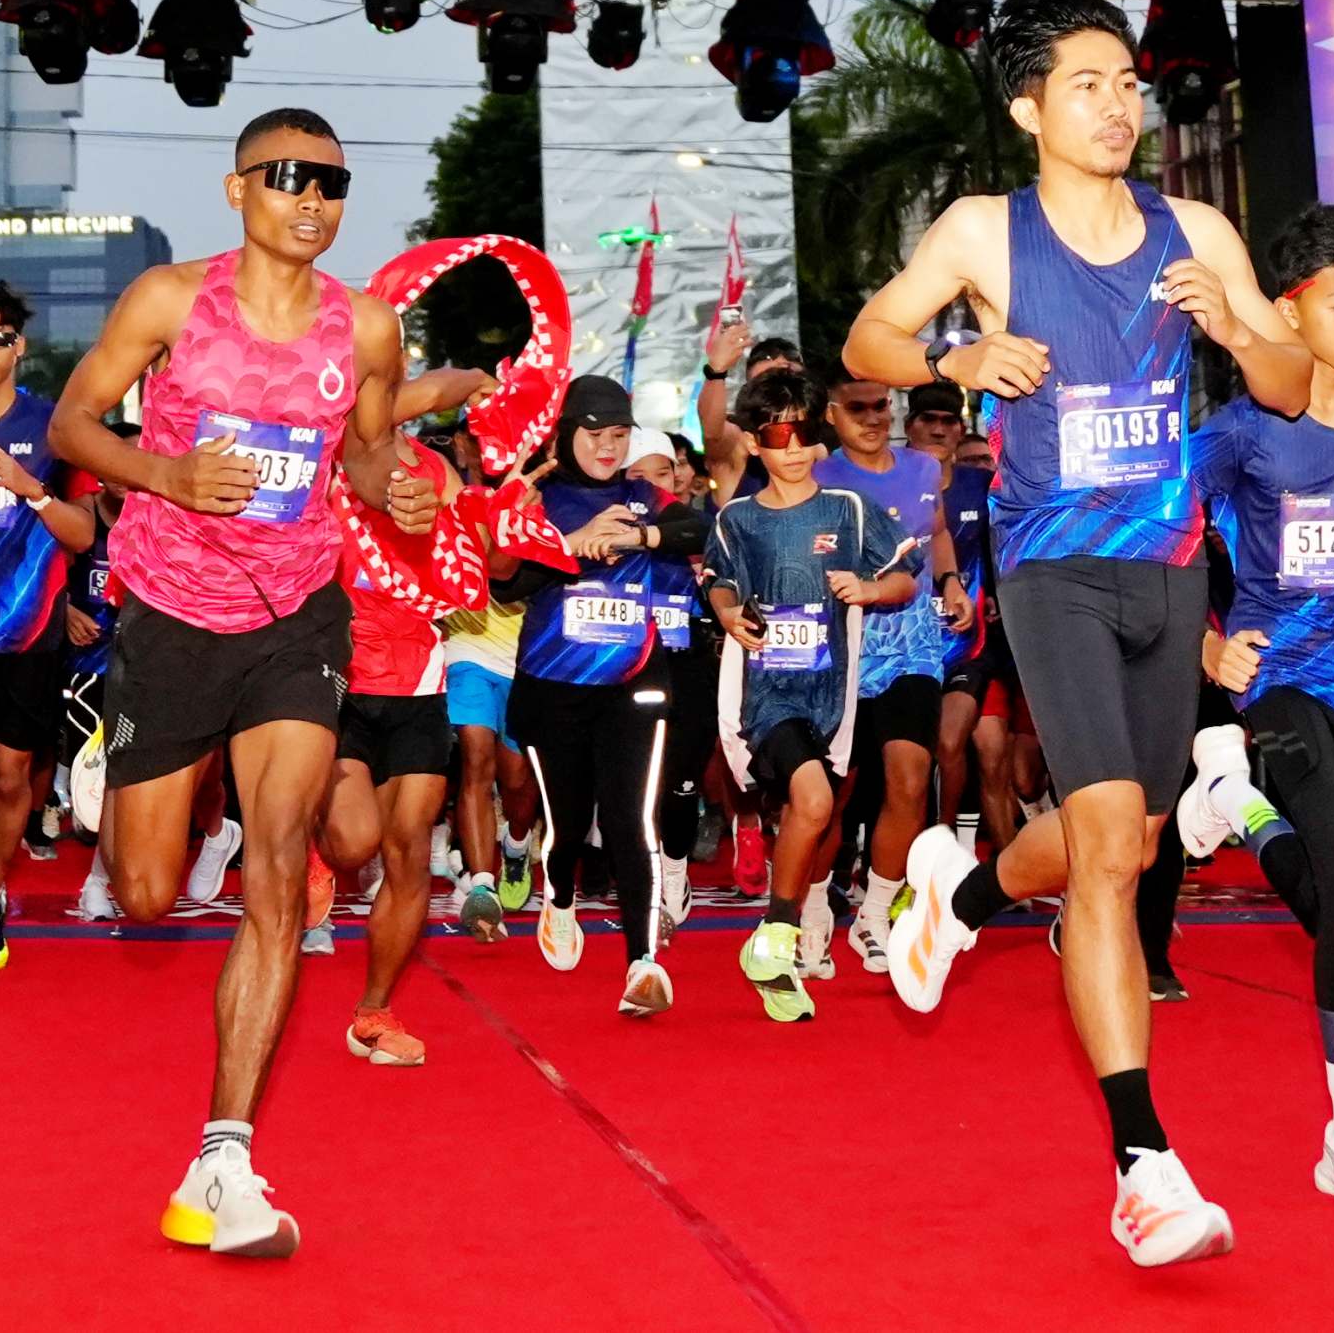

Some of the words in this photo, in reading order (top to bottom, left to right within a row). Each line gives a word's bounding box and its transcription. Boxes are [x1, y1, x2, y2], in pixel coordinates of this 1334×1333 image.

[31, 216, 133, 235] MERCURE
[289, 427, 317, 443] KAI
[1076, 410, 1159, 450] 50193
[576, 599, 627, 622] 51448
